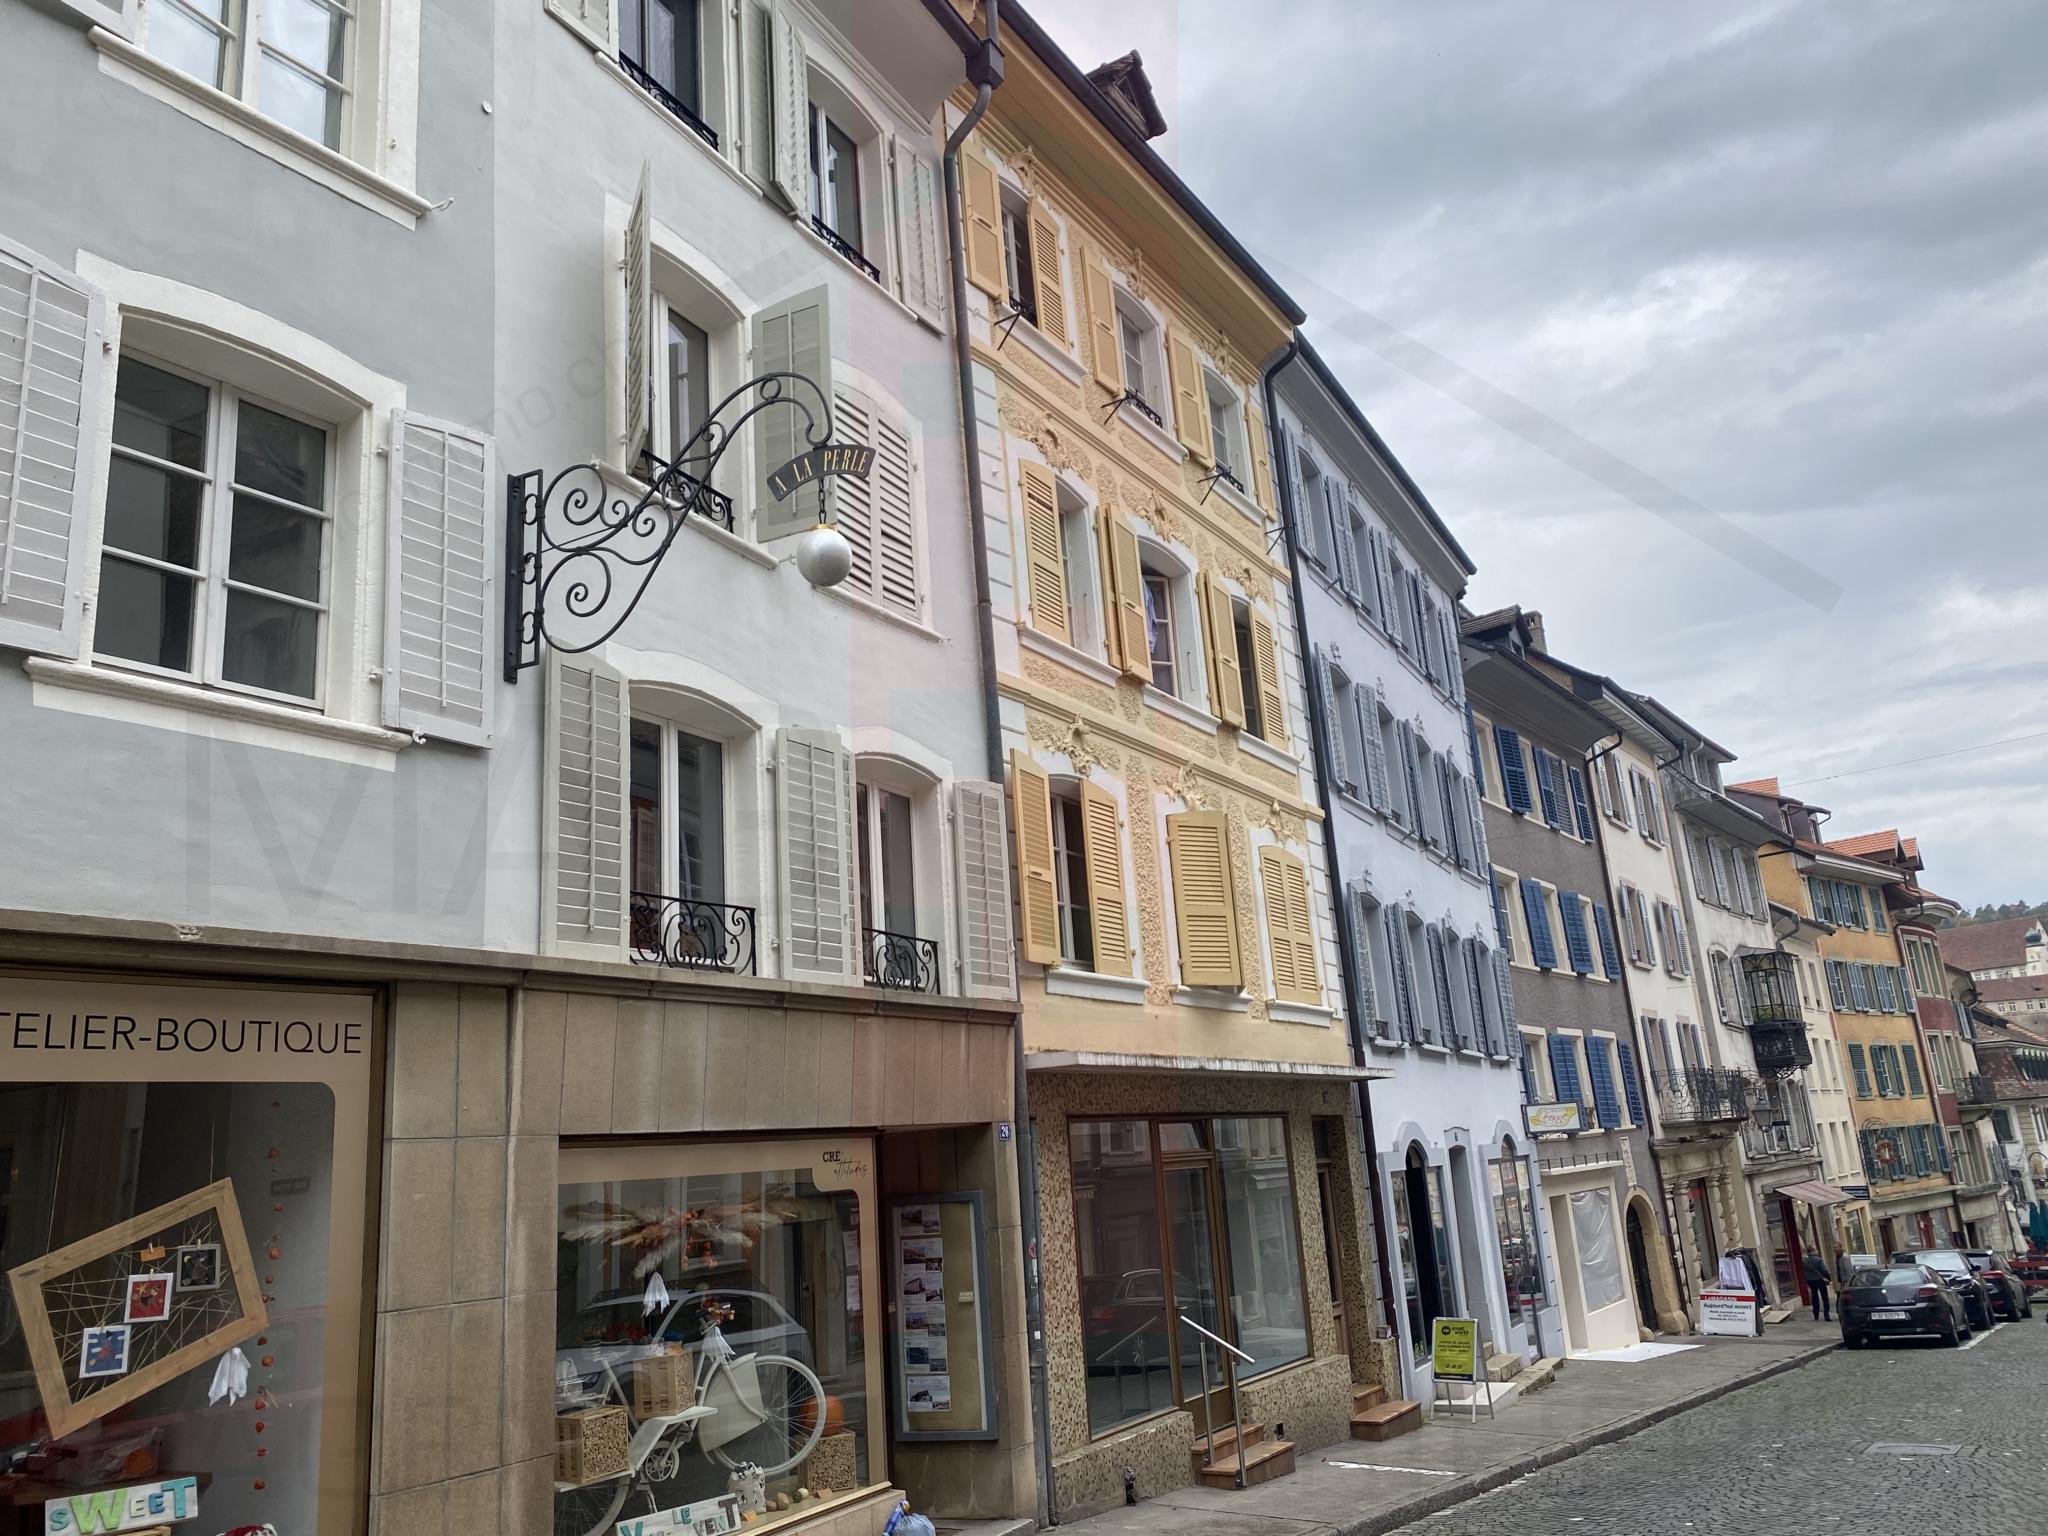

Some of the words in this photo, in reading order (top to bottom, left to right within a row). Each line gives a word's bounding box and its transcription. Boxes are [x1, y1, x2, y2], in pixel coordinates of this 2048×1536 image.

[775, 476, 788, 495] A
[793, 457, 813, 482] LA
[823, 448, 870, 473] PERLE
[50, 1475, 196, 1534] SWEET
[671, 1506, 692, 1525] LE
[693, 1496, 738, 1536] VENT
